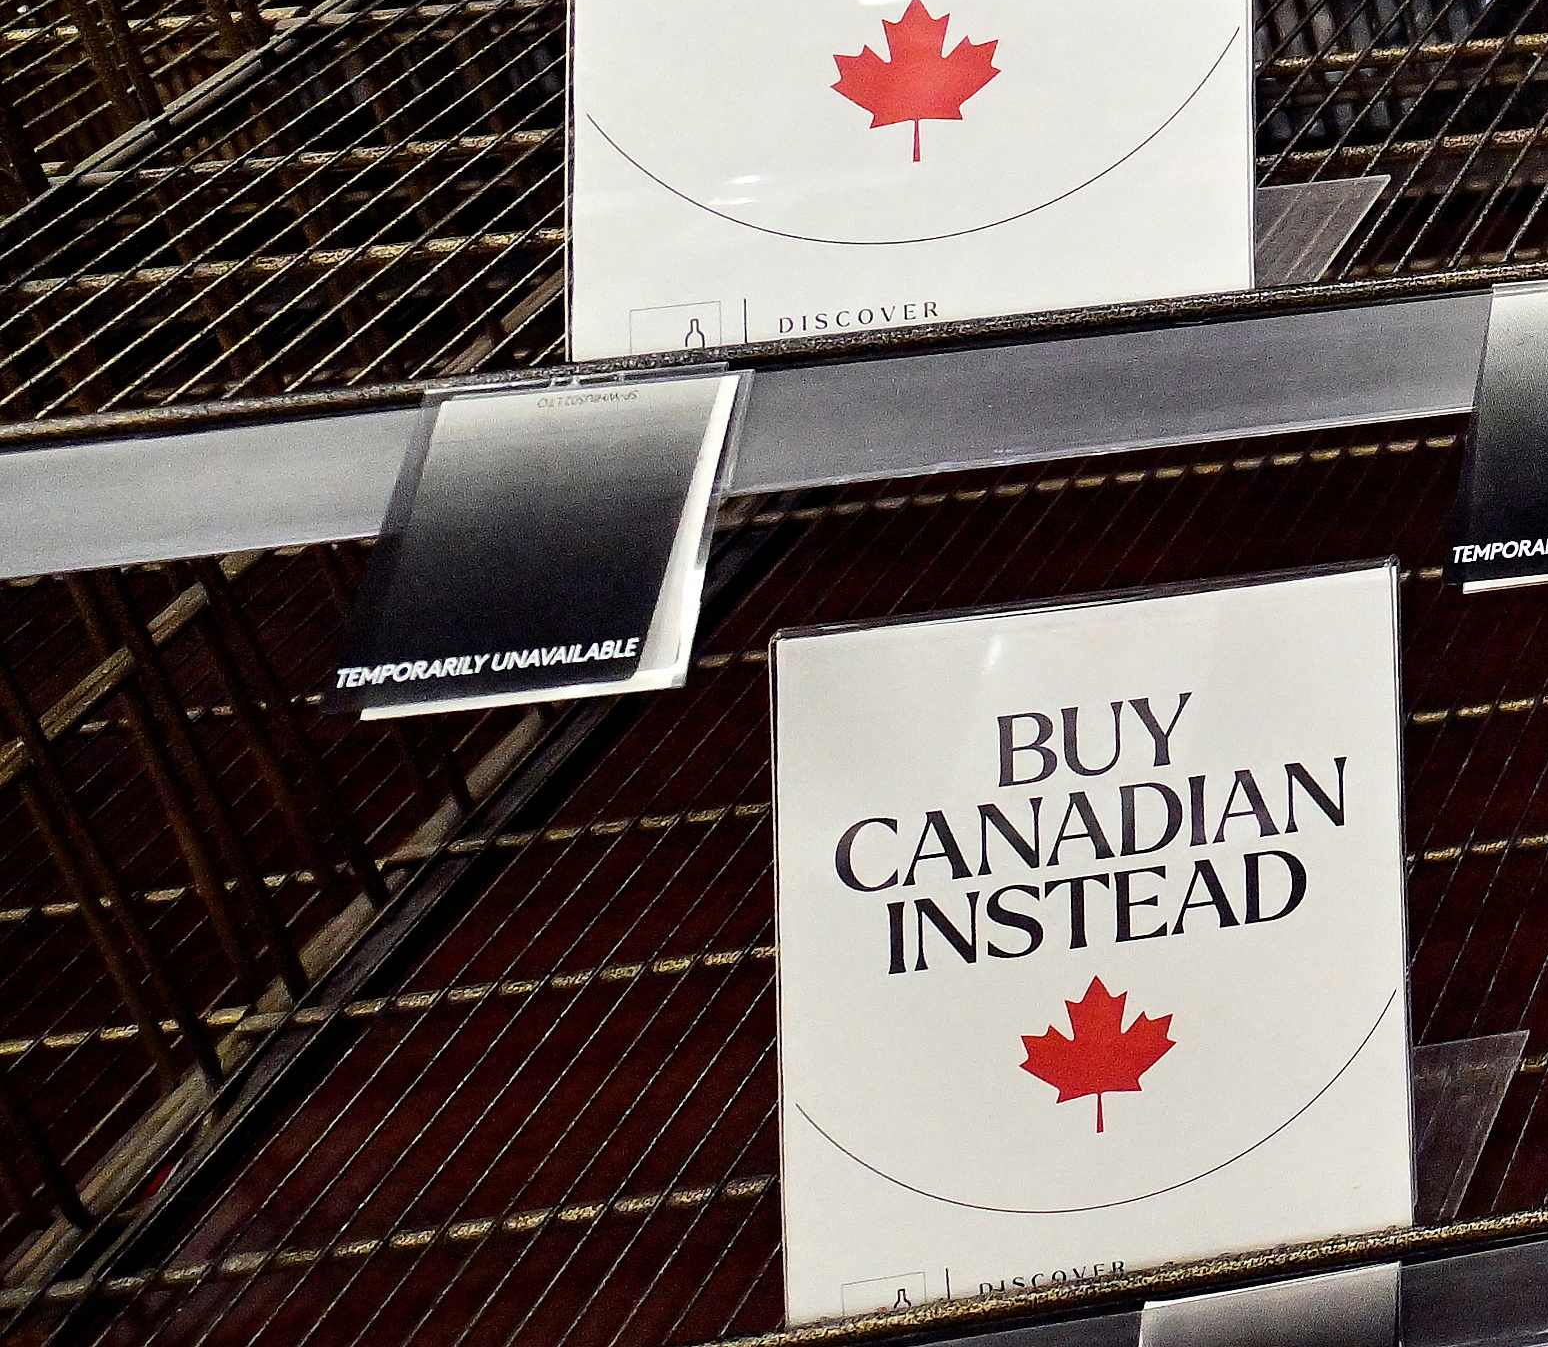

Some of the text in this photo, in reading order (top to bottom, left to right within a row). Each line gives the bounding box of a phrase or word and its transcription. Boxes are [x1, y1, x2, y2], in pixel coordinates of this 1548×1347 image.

[778, 301, 940, 335] DISCOVER
[336, 637, 638, 688] TEMPORARILY UNAVAILABLE
[997, 692, 1193, 787] BUY
[835, 757, 1347, 892] CANADIAN
[887, 850, 1308, 975] INSTEAD
